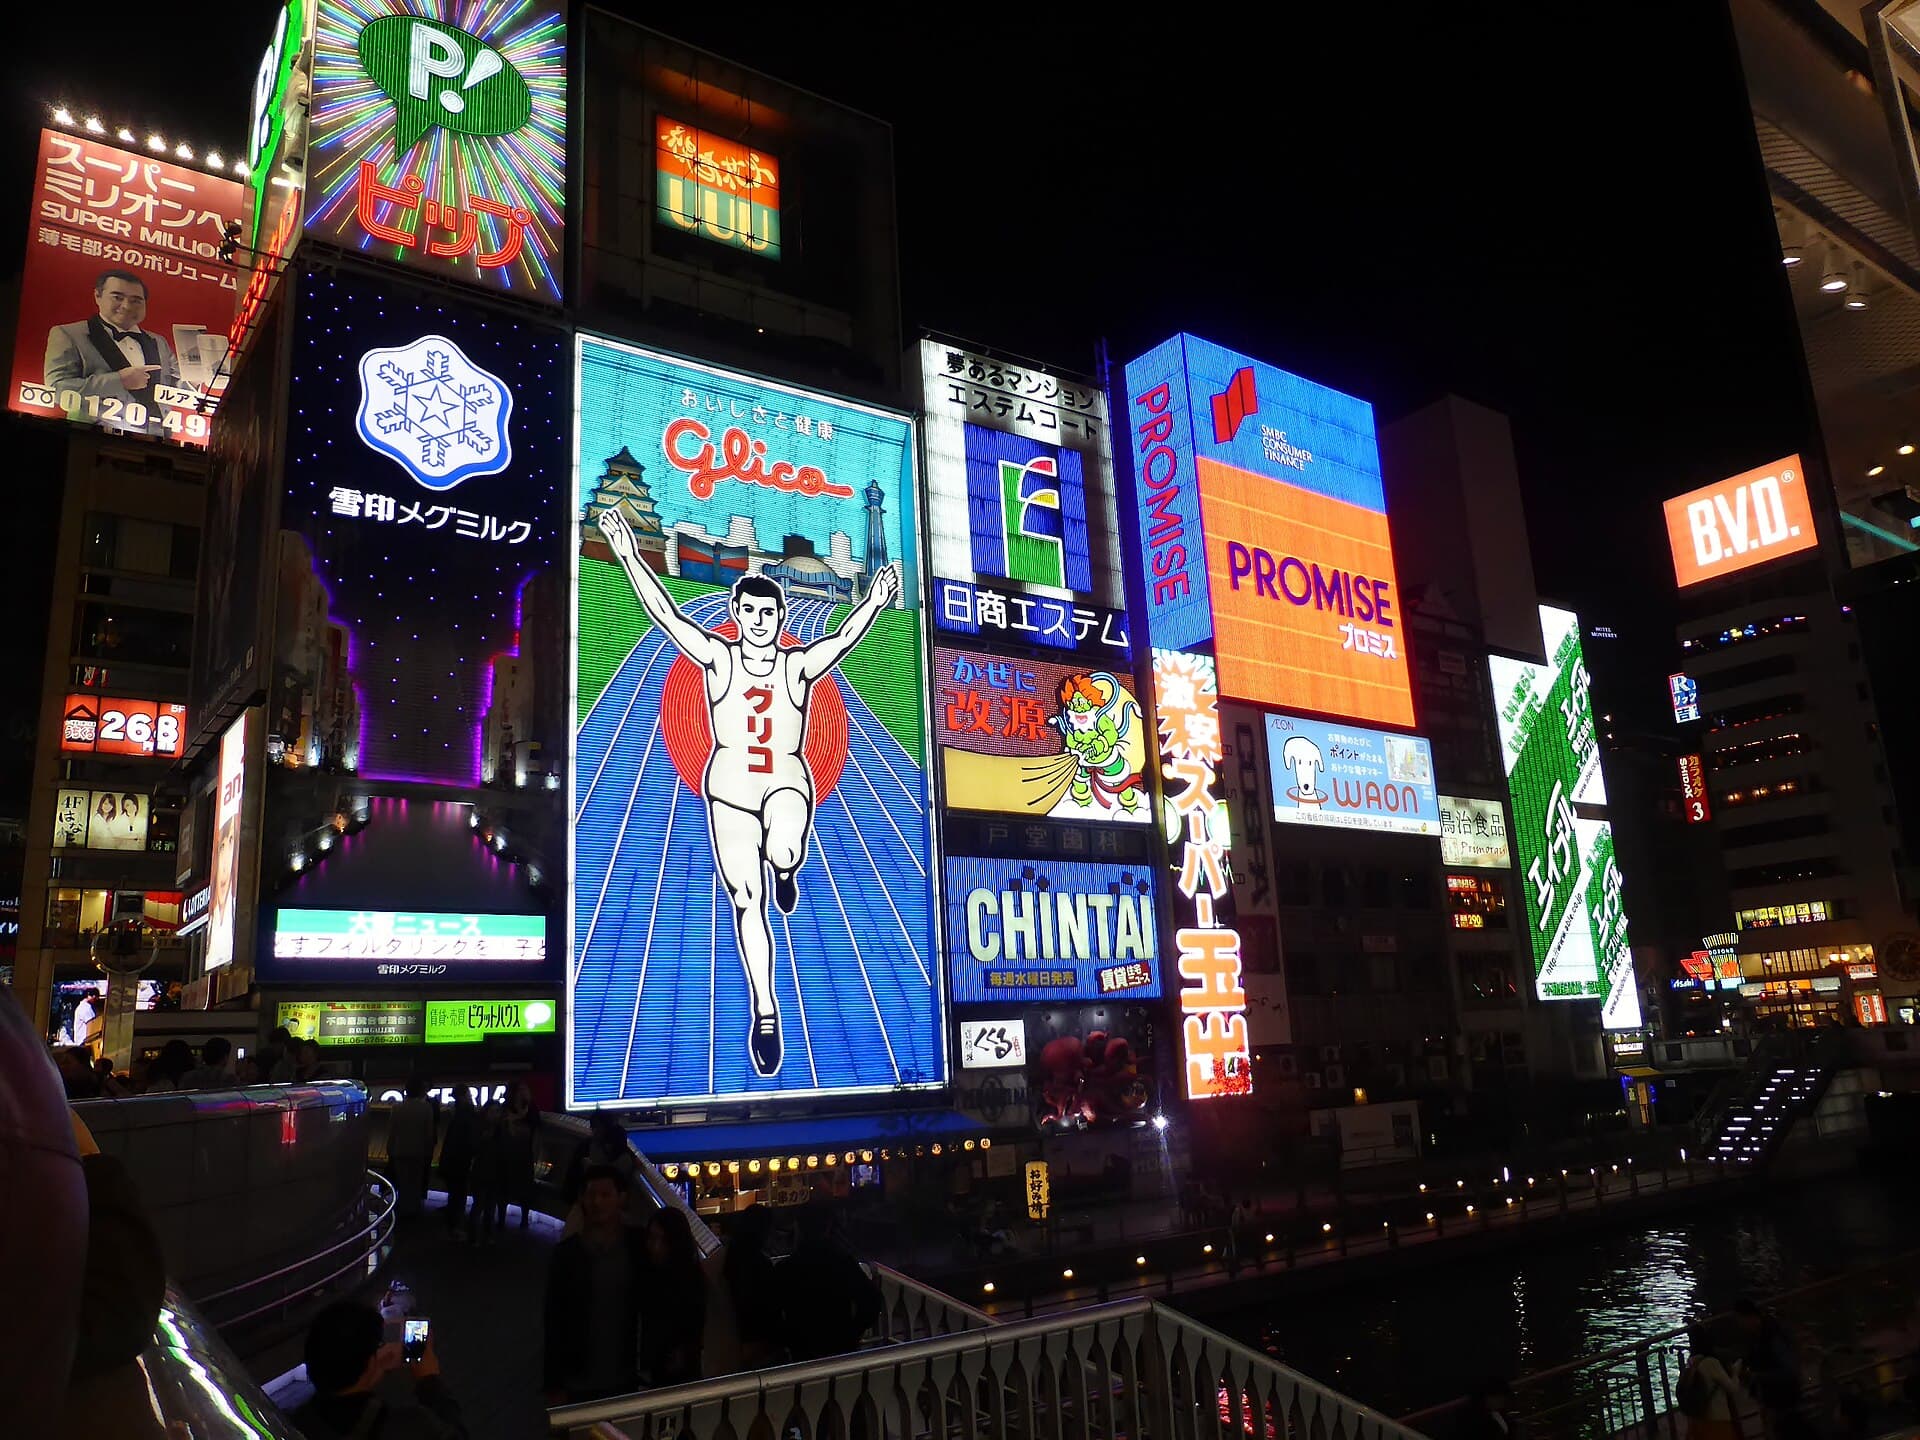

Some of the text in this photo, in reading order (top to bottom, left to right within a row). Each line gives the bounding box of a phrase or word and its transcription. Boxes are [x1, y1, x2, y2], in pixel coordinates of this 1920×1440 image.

[409, 22, 503, 114] P!
[48, 136, 196, 192] スーパー
[40, 199, 132, 238] SUPER
[358, 160, 532, 268] ピップ
[38, 227, 238, 290] 薄毛部分のボリューム
[946, 352, 1095, 409] 夢あるマンション
[681, 389, 833, 440] おいしさと健康
[948, 383, 1097, 440] エステムコート
[1261, 424, 1287, 441] SMBC
[663, 417, 855, 499] Glico
[1263, 437, 1314, 464] CONSUMER
[1264, 448, 1306, 472] FINANCE
[328, 485, 532, 544] 雪印メグミルク
[1136, 382, 1190, 606] PROMISE
[1687, 475, 1801, 567] B.V.D.
[1227, 540, 1393, 626] PROMISE
[944, 584, 1129, 648] 日商エステム
[1339, 622, 1397, 660] プロミス
[952, 655, 1037, 692] かぜに
[100, 710, 180, 744] 268
[742, 684, 774, 774] グリコ
[943, 690, 1047, 742] 改源
[62, 796, 84, 809] 4F
[1332, 777, 1419, 814] WAON
[1692, 802, 1704, 821] 3
[1528, 778, 1581, 932] エイブル
[967, 887, 1155, 962] CHINTAI
[377, 963, 447, 976] 雪印メグミルク
[468, 1003, 521, 1029] ピタットハウス
